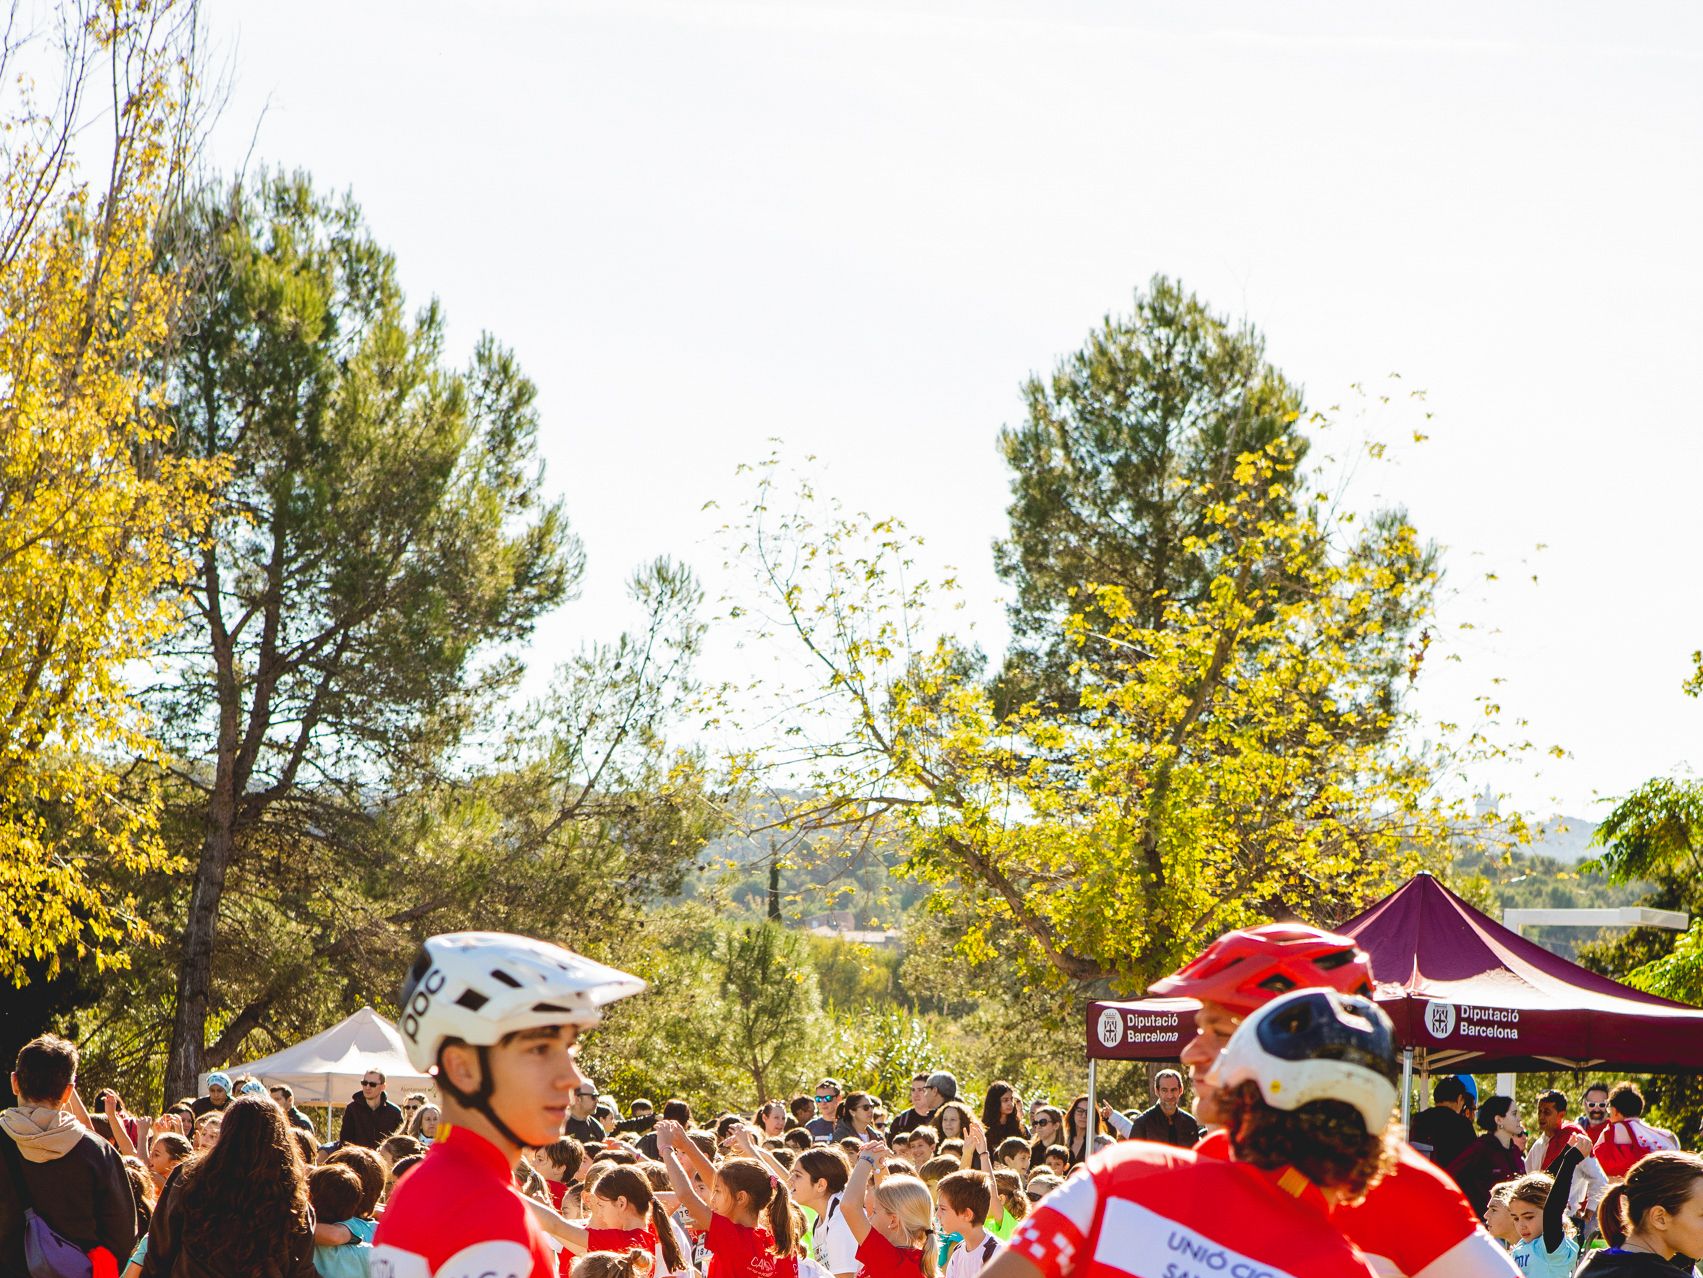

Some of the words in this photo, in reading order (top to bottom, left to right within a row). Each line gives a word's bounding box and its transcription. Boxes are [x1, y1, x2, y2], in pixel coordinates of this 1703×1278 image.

[1127, 1013, 1179, 1029] Diputació
[1460, 1005, 1520, 1022] Diputació
[1127, 1030, 1179, 1042] Barcelona
[1460, 1021, 1519, 1039] Barcelona
[1167, 1231, 1228, 1271] UNIÓ
